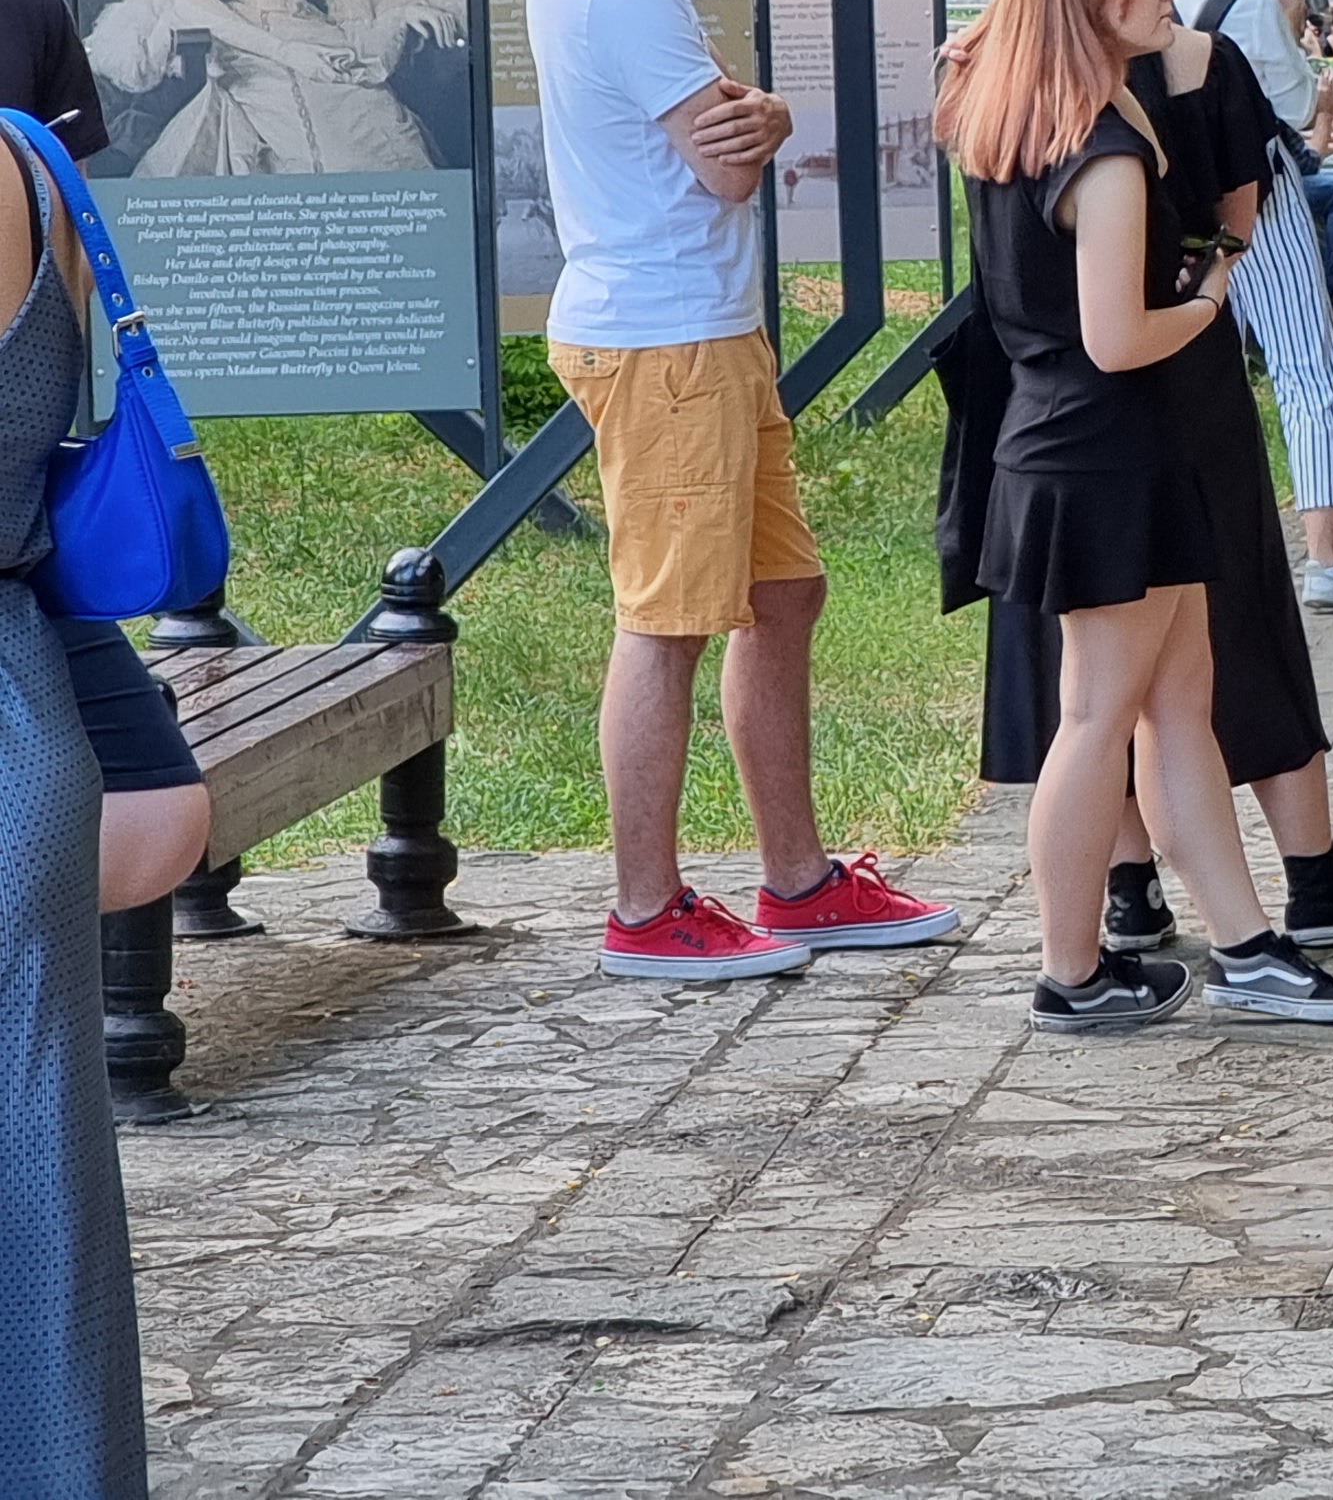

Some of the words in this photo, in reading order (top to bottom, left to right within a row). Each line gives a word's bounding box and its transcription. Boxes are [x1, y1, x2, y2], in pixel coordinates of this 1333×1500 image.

[127, 198, 158, 211] Jelena
[160, 199, 181, 208] was
[184, 195, 229, 208] versatile
[231, 194, 251, 206] and
[305, 192, 327, 204] and
[329, 192, 347, 203] she
[348, 194, 369, 203] was
[372, 191, 400, 202] loved
[401, 190, 418, 205] for
[420, 190, 439, 201] her
[117, 212, 155, 227] charity
[157, 212, 184, 224] work
[186, 211, 207, 224] and
[209, 209, 253, 225] personal
[299, 208, 319, 220] She
[320, 207, 350, 222] spoke
[351, 206, 389, 219] several
[138, 227, 174, 244] played
[176, 227, 192, 239] the
[229, 225, 250, 237] and
[252, 225, 283, 237] wrote
[325, 223, 345, 235] She
[347, 225, 368, 234] was
[369, 221, 414, 236] engaged
[416, 221, 427, 233] in
[297, 239, 318, 251] and
[165, 258, 187, 270] Her
[188, 257, 210, 269] idea
[212, 256, 233, 268] and
[235, 255, 261, 270] draft
[263, 255, 298, 269] design
[300, 253, 313, 269] of
[314, 253, 330, 266] the
[332, 253, 390, 265] monument
[392, 254, 404, 264] to
[133, 274, 169, 288] Bishop
[171, 272, 208, 285] Danilo
[280, 272, 301, 282] was
[303, 268, 348, 284] accepted
[350, 269, 365, 284] by
[366, 268, 382, 280] the
[385, 267, 436, 279] architects
[189, 288, 235, 300] involved
[237, 288, 249, 298] in
[251, 288, 268, 298] the
[270, 284, 337, 297] construction
[165, 304, 184, 316] she
[186, 306, 207, 315] was
[248, 301, 265, 313] the
[267, 301, 310, 313] Russian
[313, 300, 353, 314] literary
[355, 298, 405, 313] magazine
[407, 297, 440, 309] under
[210, 318, 235, 330] Blue
[237, 317, 285, 331] Butterfly
[287, 314, 339, 331] published
[340, 315, 359, 327] her
[360, 316, 393, 325] verses
[395, 312, 445, 324] dedicated
[200, 336, 220, 345] one
[222, 332, 250, 345] could
[253, 332, 296, 346] imagine
[299, 331, 319, 343] this
[320, 330, 382, 345] pseudonym
[384, 328, 418, 340] would
[419, 328, 445, 339] later
[188, 349, 205, 361] the
[207, 350, 257, 363] composer
[259, 348, 306, 359] Giacomo
[309, 345, 349, 358] Puccini
[352, 346, 362, 357] to
[364, 344, 408, 356] dedicate
[409, 343, 426, 355] his
[195, 366, 224, 380] opera
[226, 364, 278, 377] Madame
[280, 362, 334, 377] Butterfly
[335, 363, 347, 374] to
[349, 360, 384, 375] Queen
[670, 927, 705, 951] FILA
